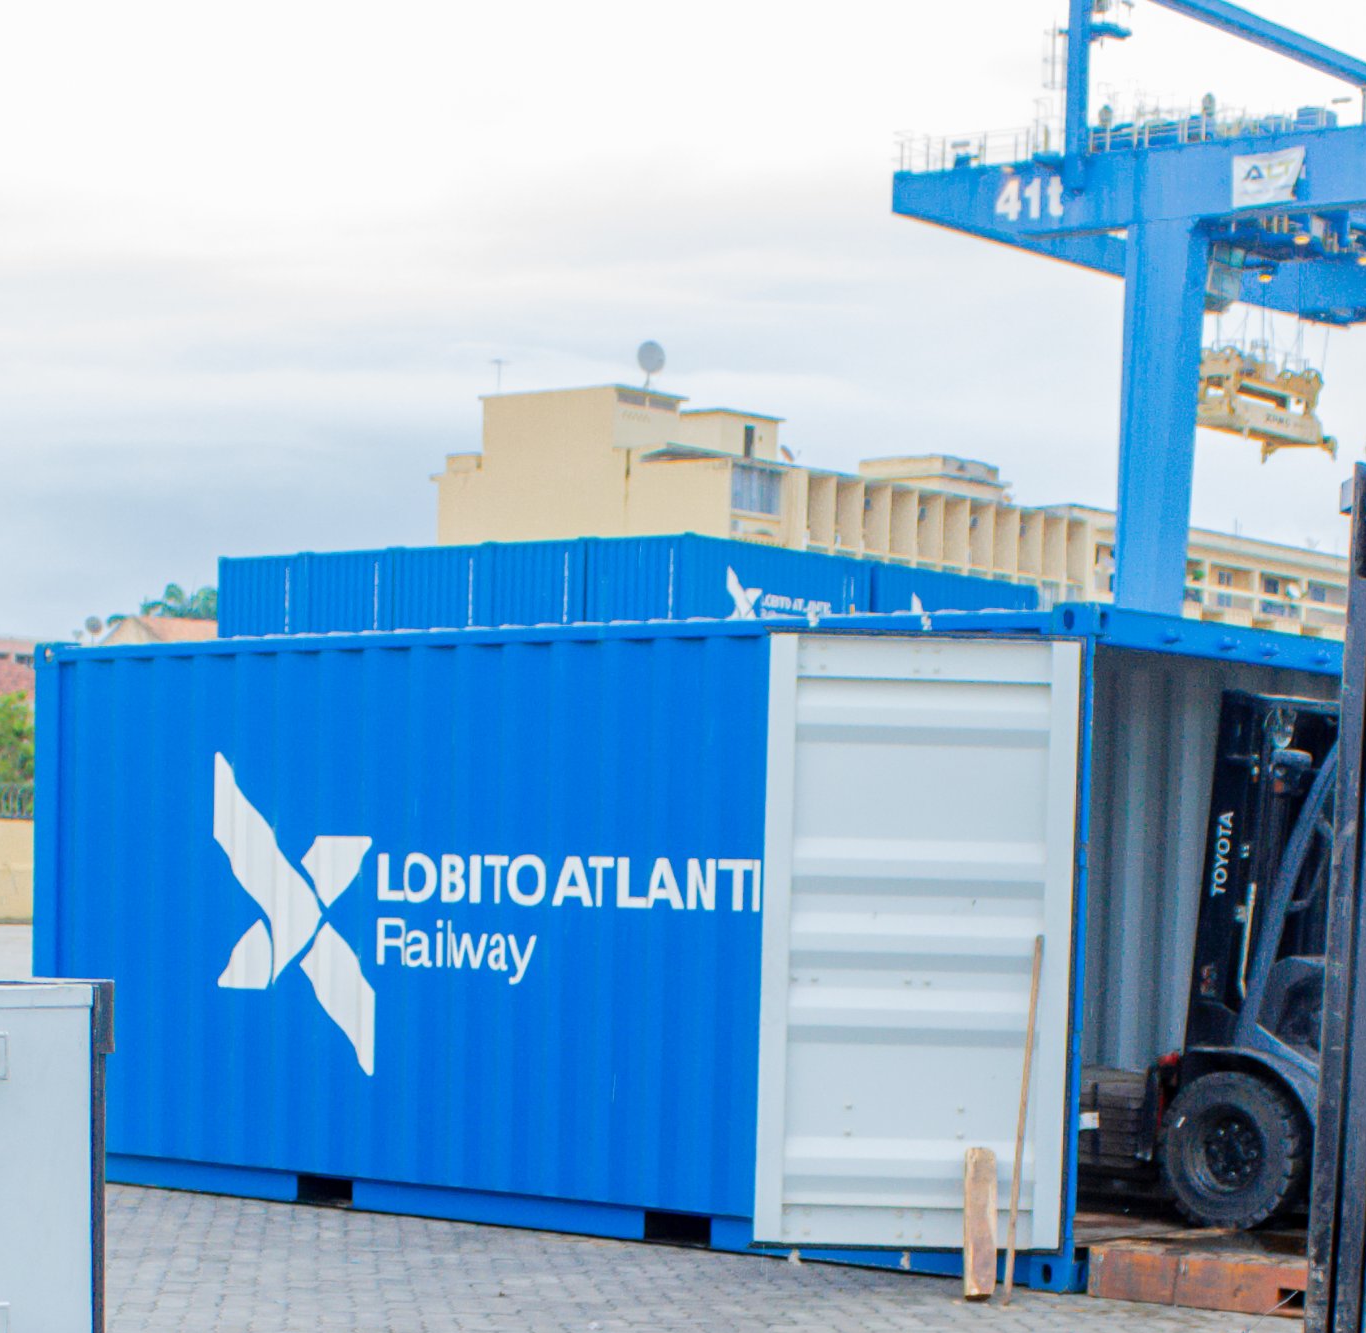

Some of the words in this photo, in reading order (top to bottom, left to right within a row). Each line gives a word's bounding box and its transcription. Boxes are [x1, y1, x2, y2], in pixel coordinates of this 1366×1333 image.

[995, 175, 1064, 221] 41t
[376, 852, 547, 907] LOBITO
[1208, 810, 1234, 897] TOYOTA
[375, 917, 537, 986] Railway
